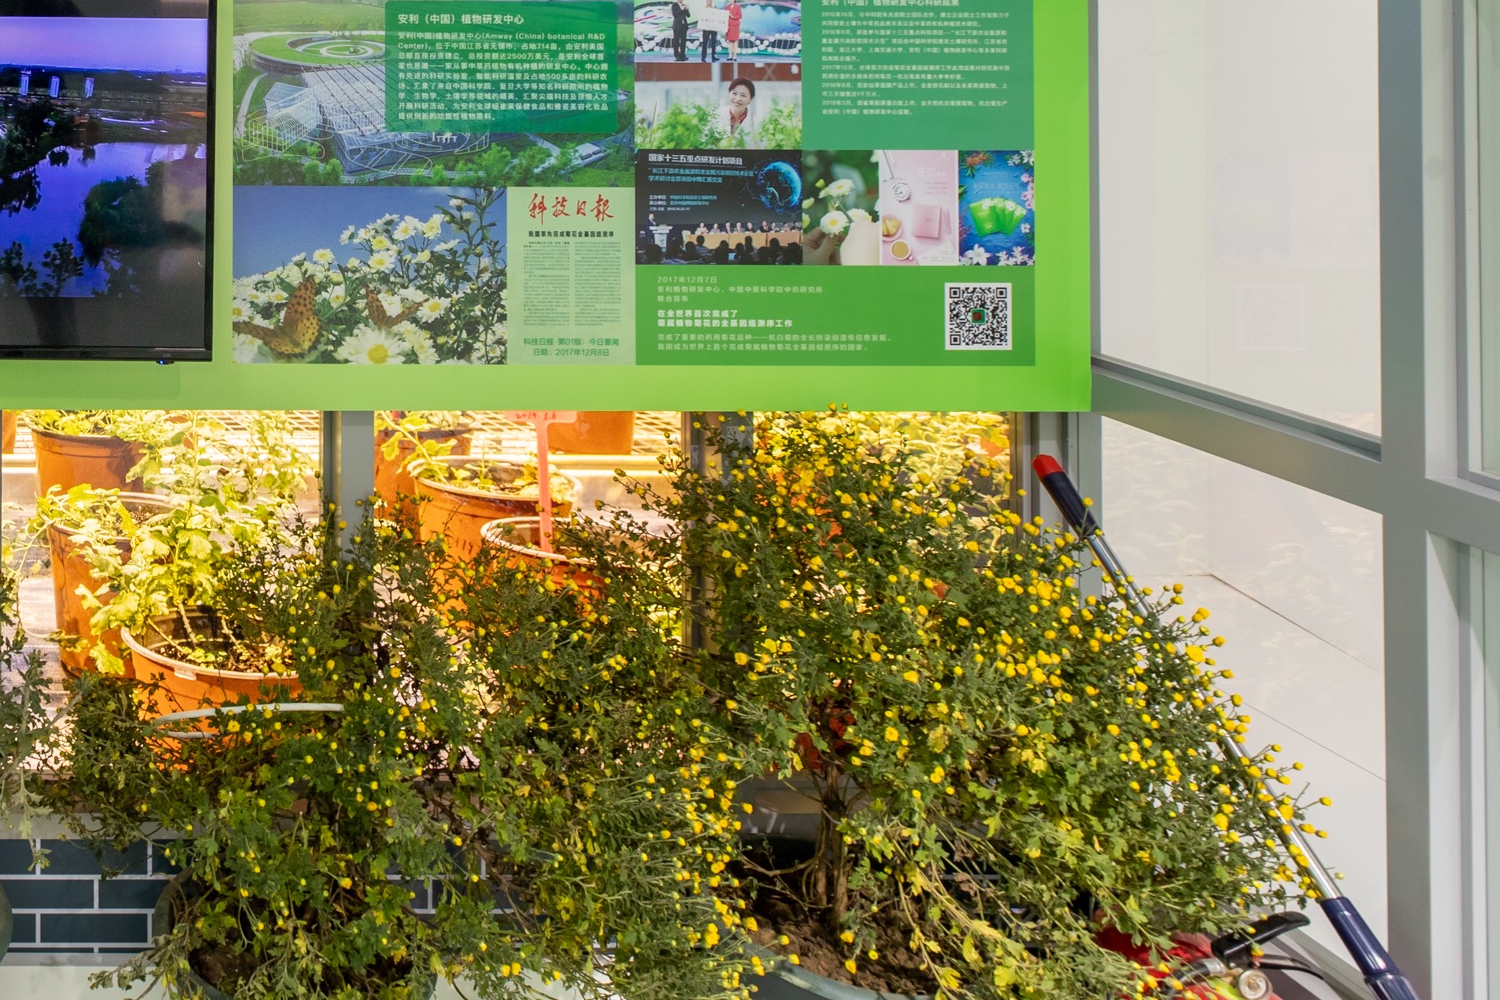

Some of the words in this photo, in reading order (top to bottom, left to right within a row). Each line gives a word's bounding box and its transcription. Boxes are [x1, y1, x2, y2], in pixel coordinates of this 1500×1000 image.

[397, 13, 525, 25] 安利（中国）植物研发中心
[515, 32, 545, 41] (China)
[547, 32, 586, 41] botanical
[587, 33, 606, 41] R&D
[657, 309, 739, 319] 在全世界首次完成了
[523, 337, 554, 346] 科技日报
